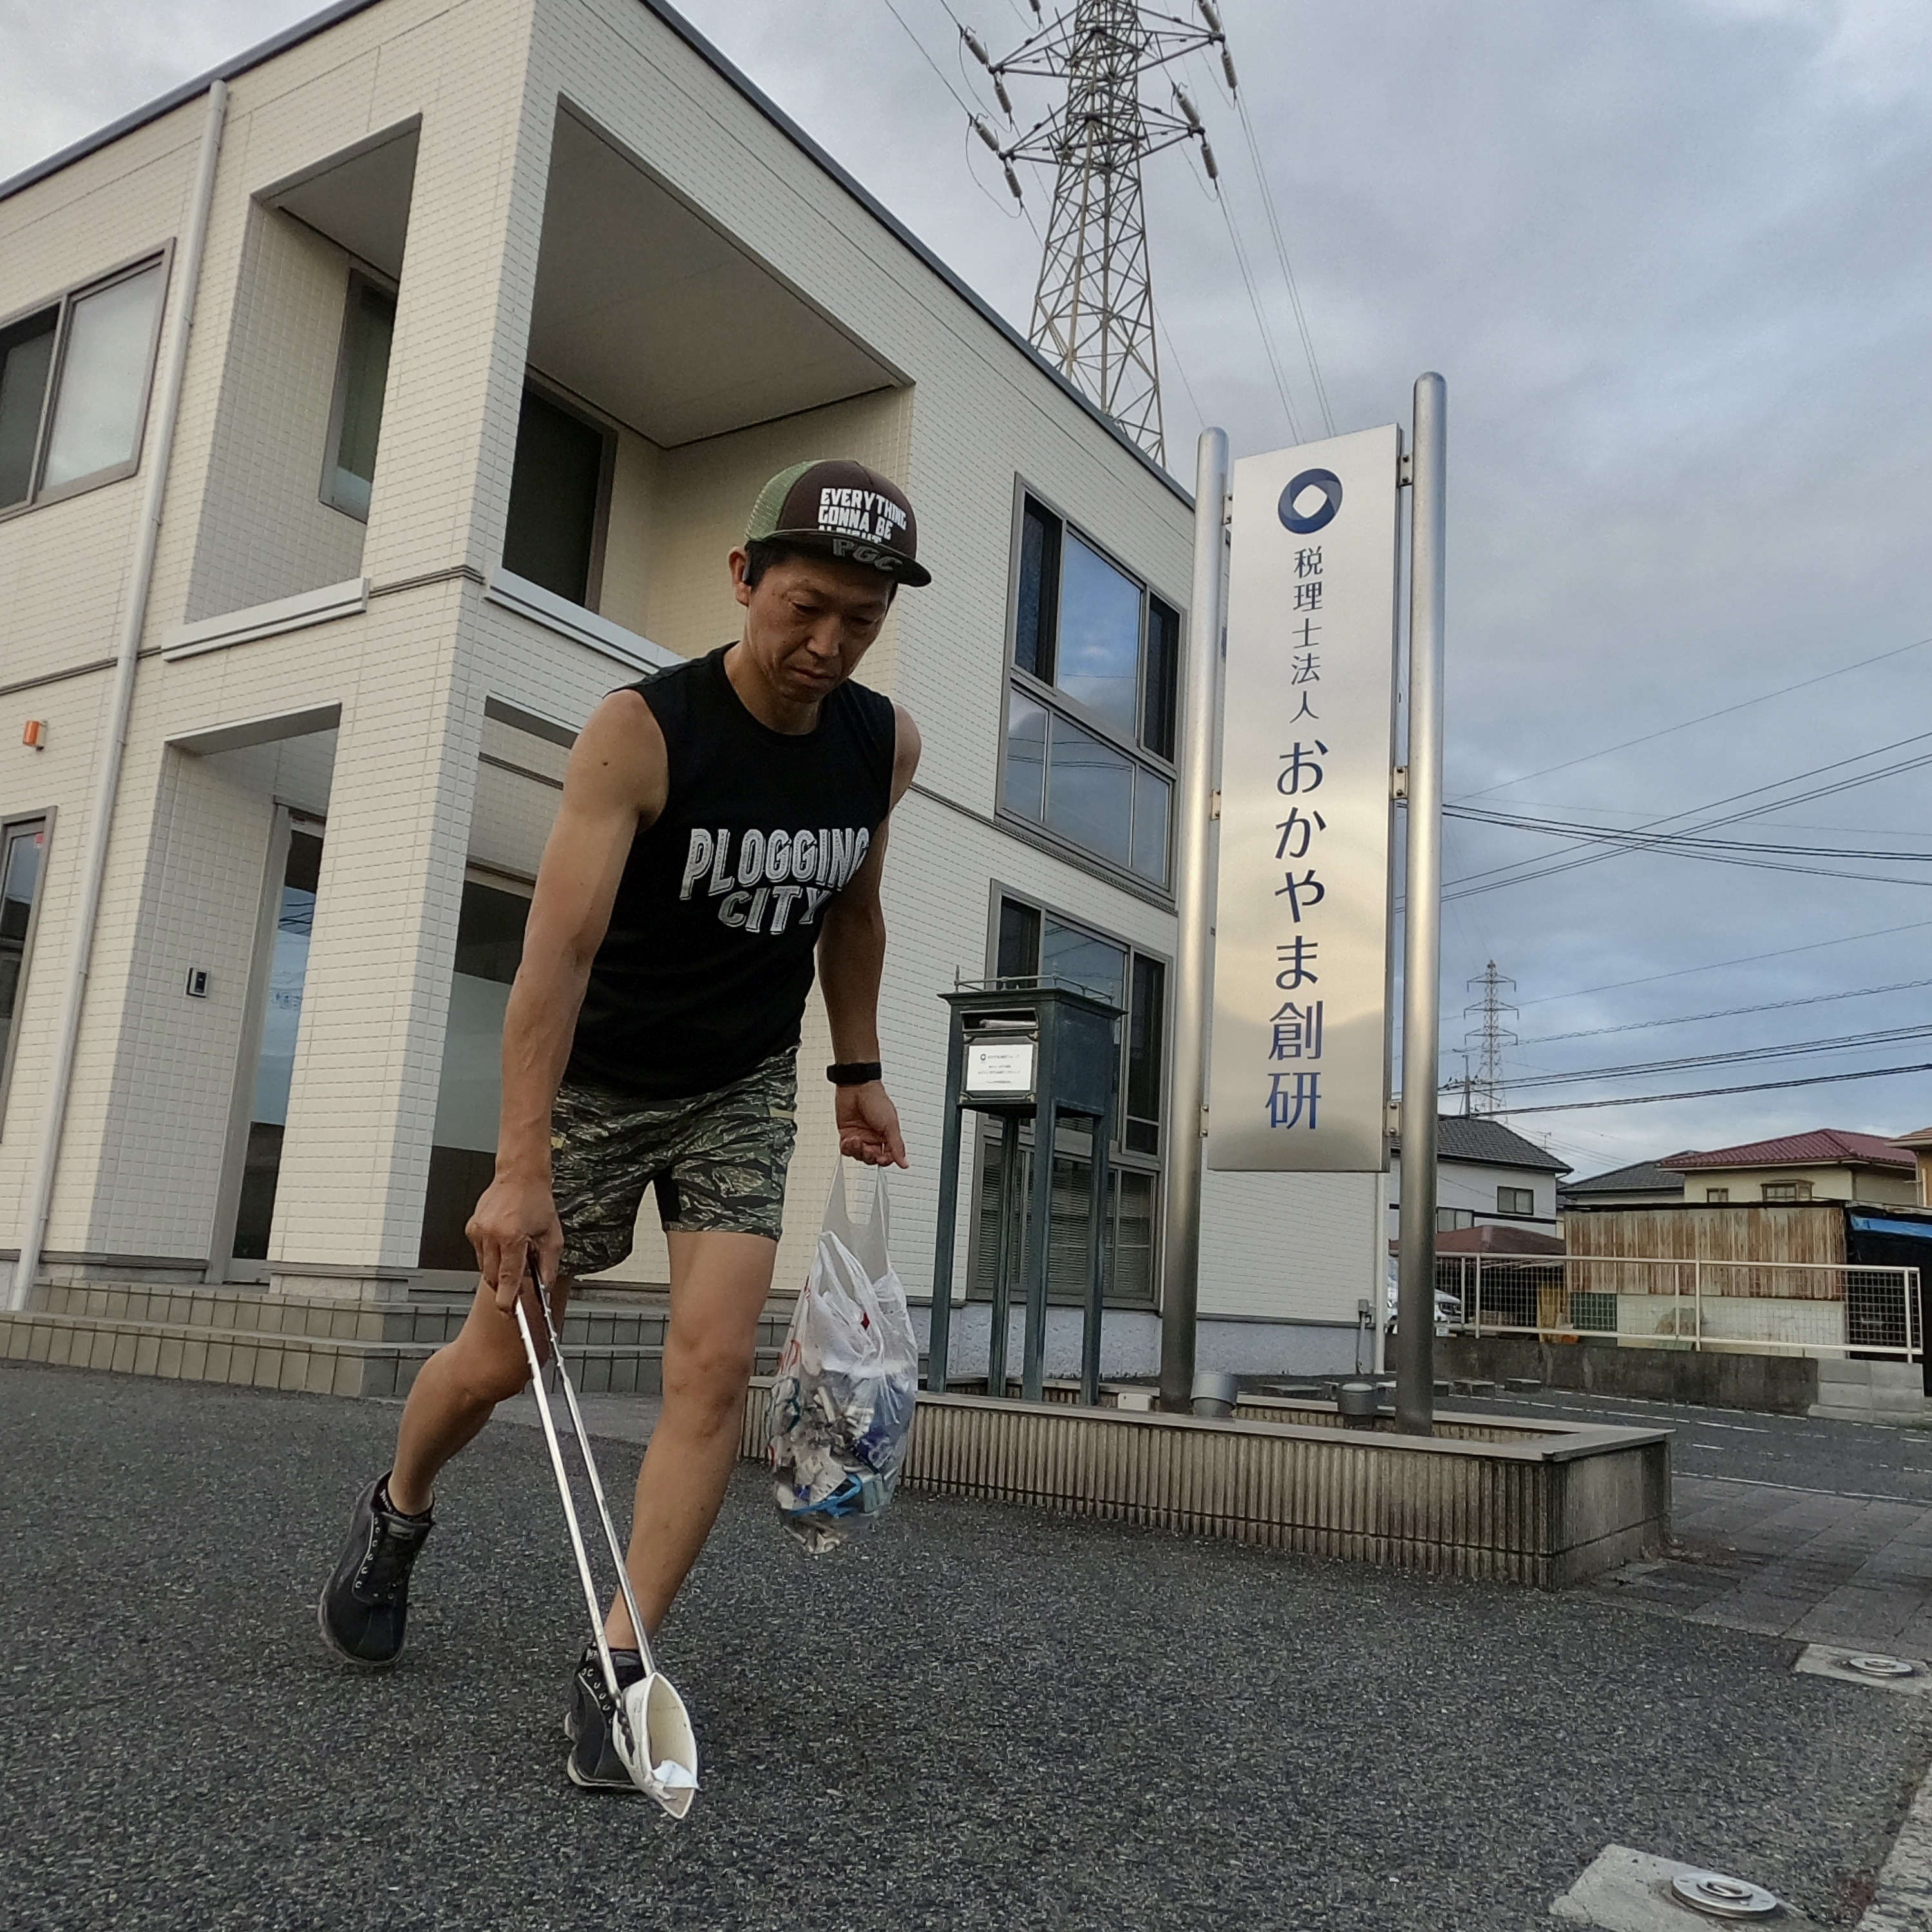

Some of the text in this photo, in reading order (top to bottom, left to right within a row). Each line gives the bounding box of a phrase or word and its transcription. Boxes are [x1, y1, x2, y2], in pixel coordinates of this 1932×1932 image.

[818, 505, 870, 533] GONNA
[875, 516, 893, 540] BE
[820, 488, 907, 531] EVERYTHING
[833, 538, 903, 571] PGC
[1264, 545, 1329, 1130] 税理士法人 おかやま創研
[718, 886, 832, 935] CITY
